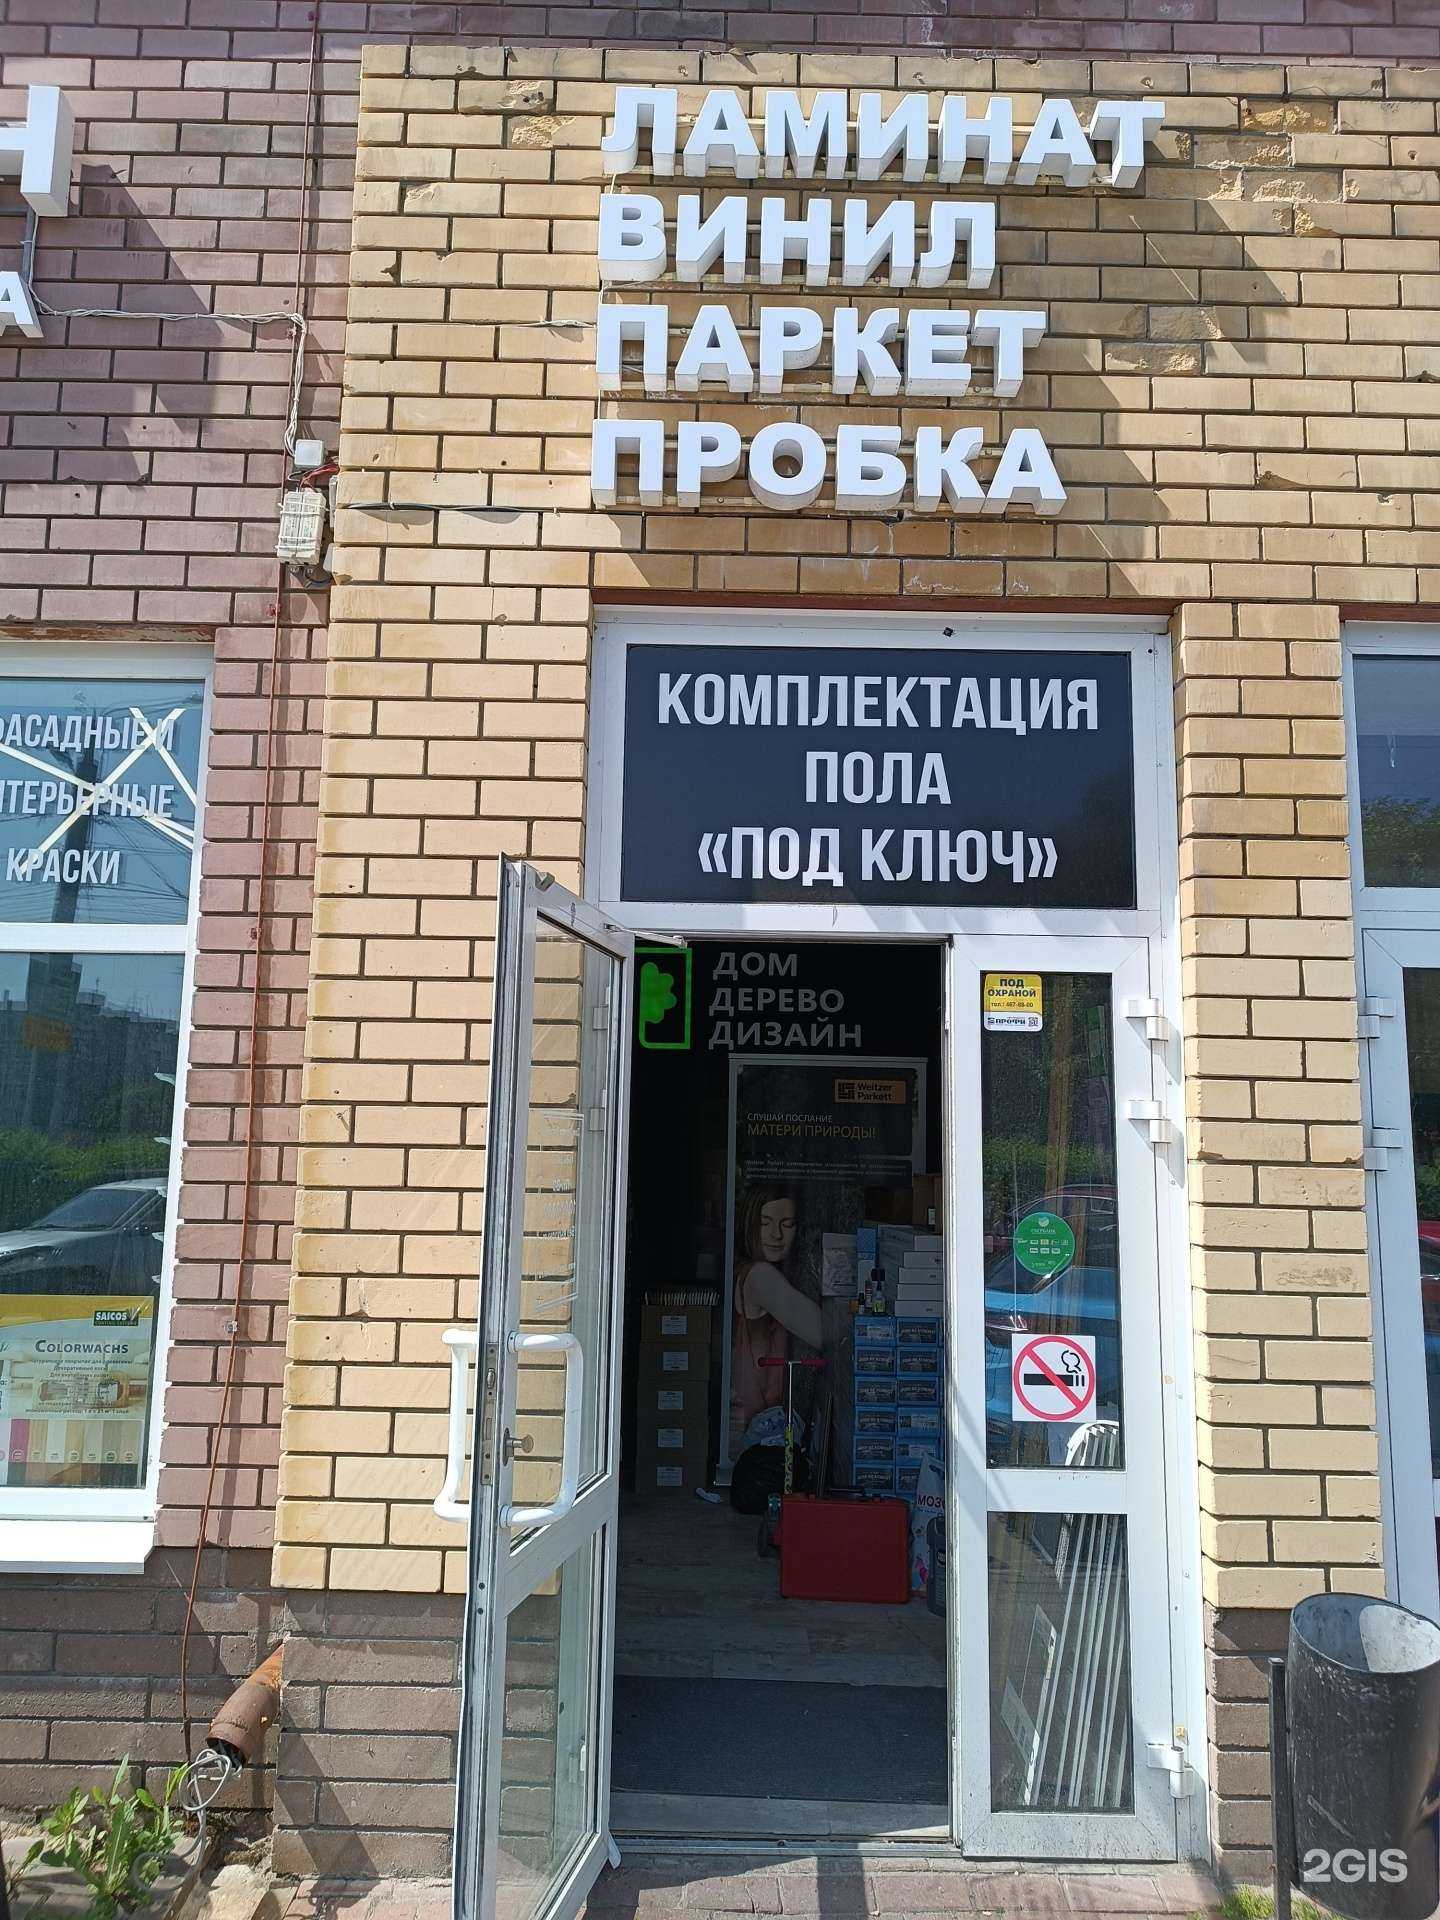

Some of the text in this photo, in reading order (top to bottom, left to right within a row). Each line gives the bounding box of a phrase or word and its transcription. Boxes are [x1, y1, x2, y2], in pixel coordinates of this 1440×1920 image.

[601, 86, 1166, 189] ЛАМИНАТ
[597, 193, 996, 289] ВИНИЛ
[596, 304, 1047, 398] ПАРКЕТ
[591, 418, 1069, 516] ПРОБКА
[657, 672, 1099, 736] КОМПЛЕКТАЦИЯ
[154, 717, 175, 751] И
[805, 751, 952, 805] ПОЛА
[6, 847, 120, 884] КРАСКИ
[698, 826, 1058, 887] «ПОД КЛЮЧ»
[712, 951, 798, 980] ДОМ
[987, 988, 1036, 997] ОХРАНОЙ
[1000, 978, 1024, 988] ПОД
[708, 987, 845, 1017] ДЕРЕВО
[708, 1017, 862, 1050] ДИЗАЙН
[857, 1081, 893, 1092] Weitzer
[857, 1092, 893, 1102] Parkett
[747, 1112, 833, 1123] СЛУШАЙ ПОСЛАНИЕ
[747, 1123, 801, 1137] МАТЕРИ
[95, 1311, 128, 1321] SAICOS
